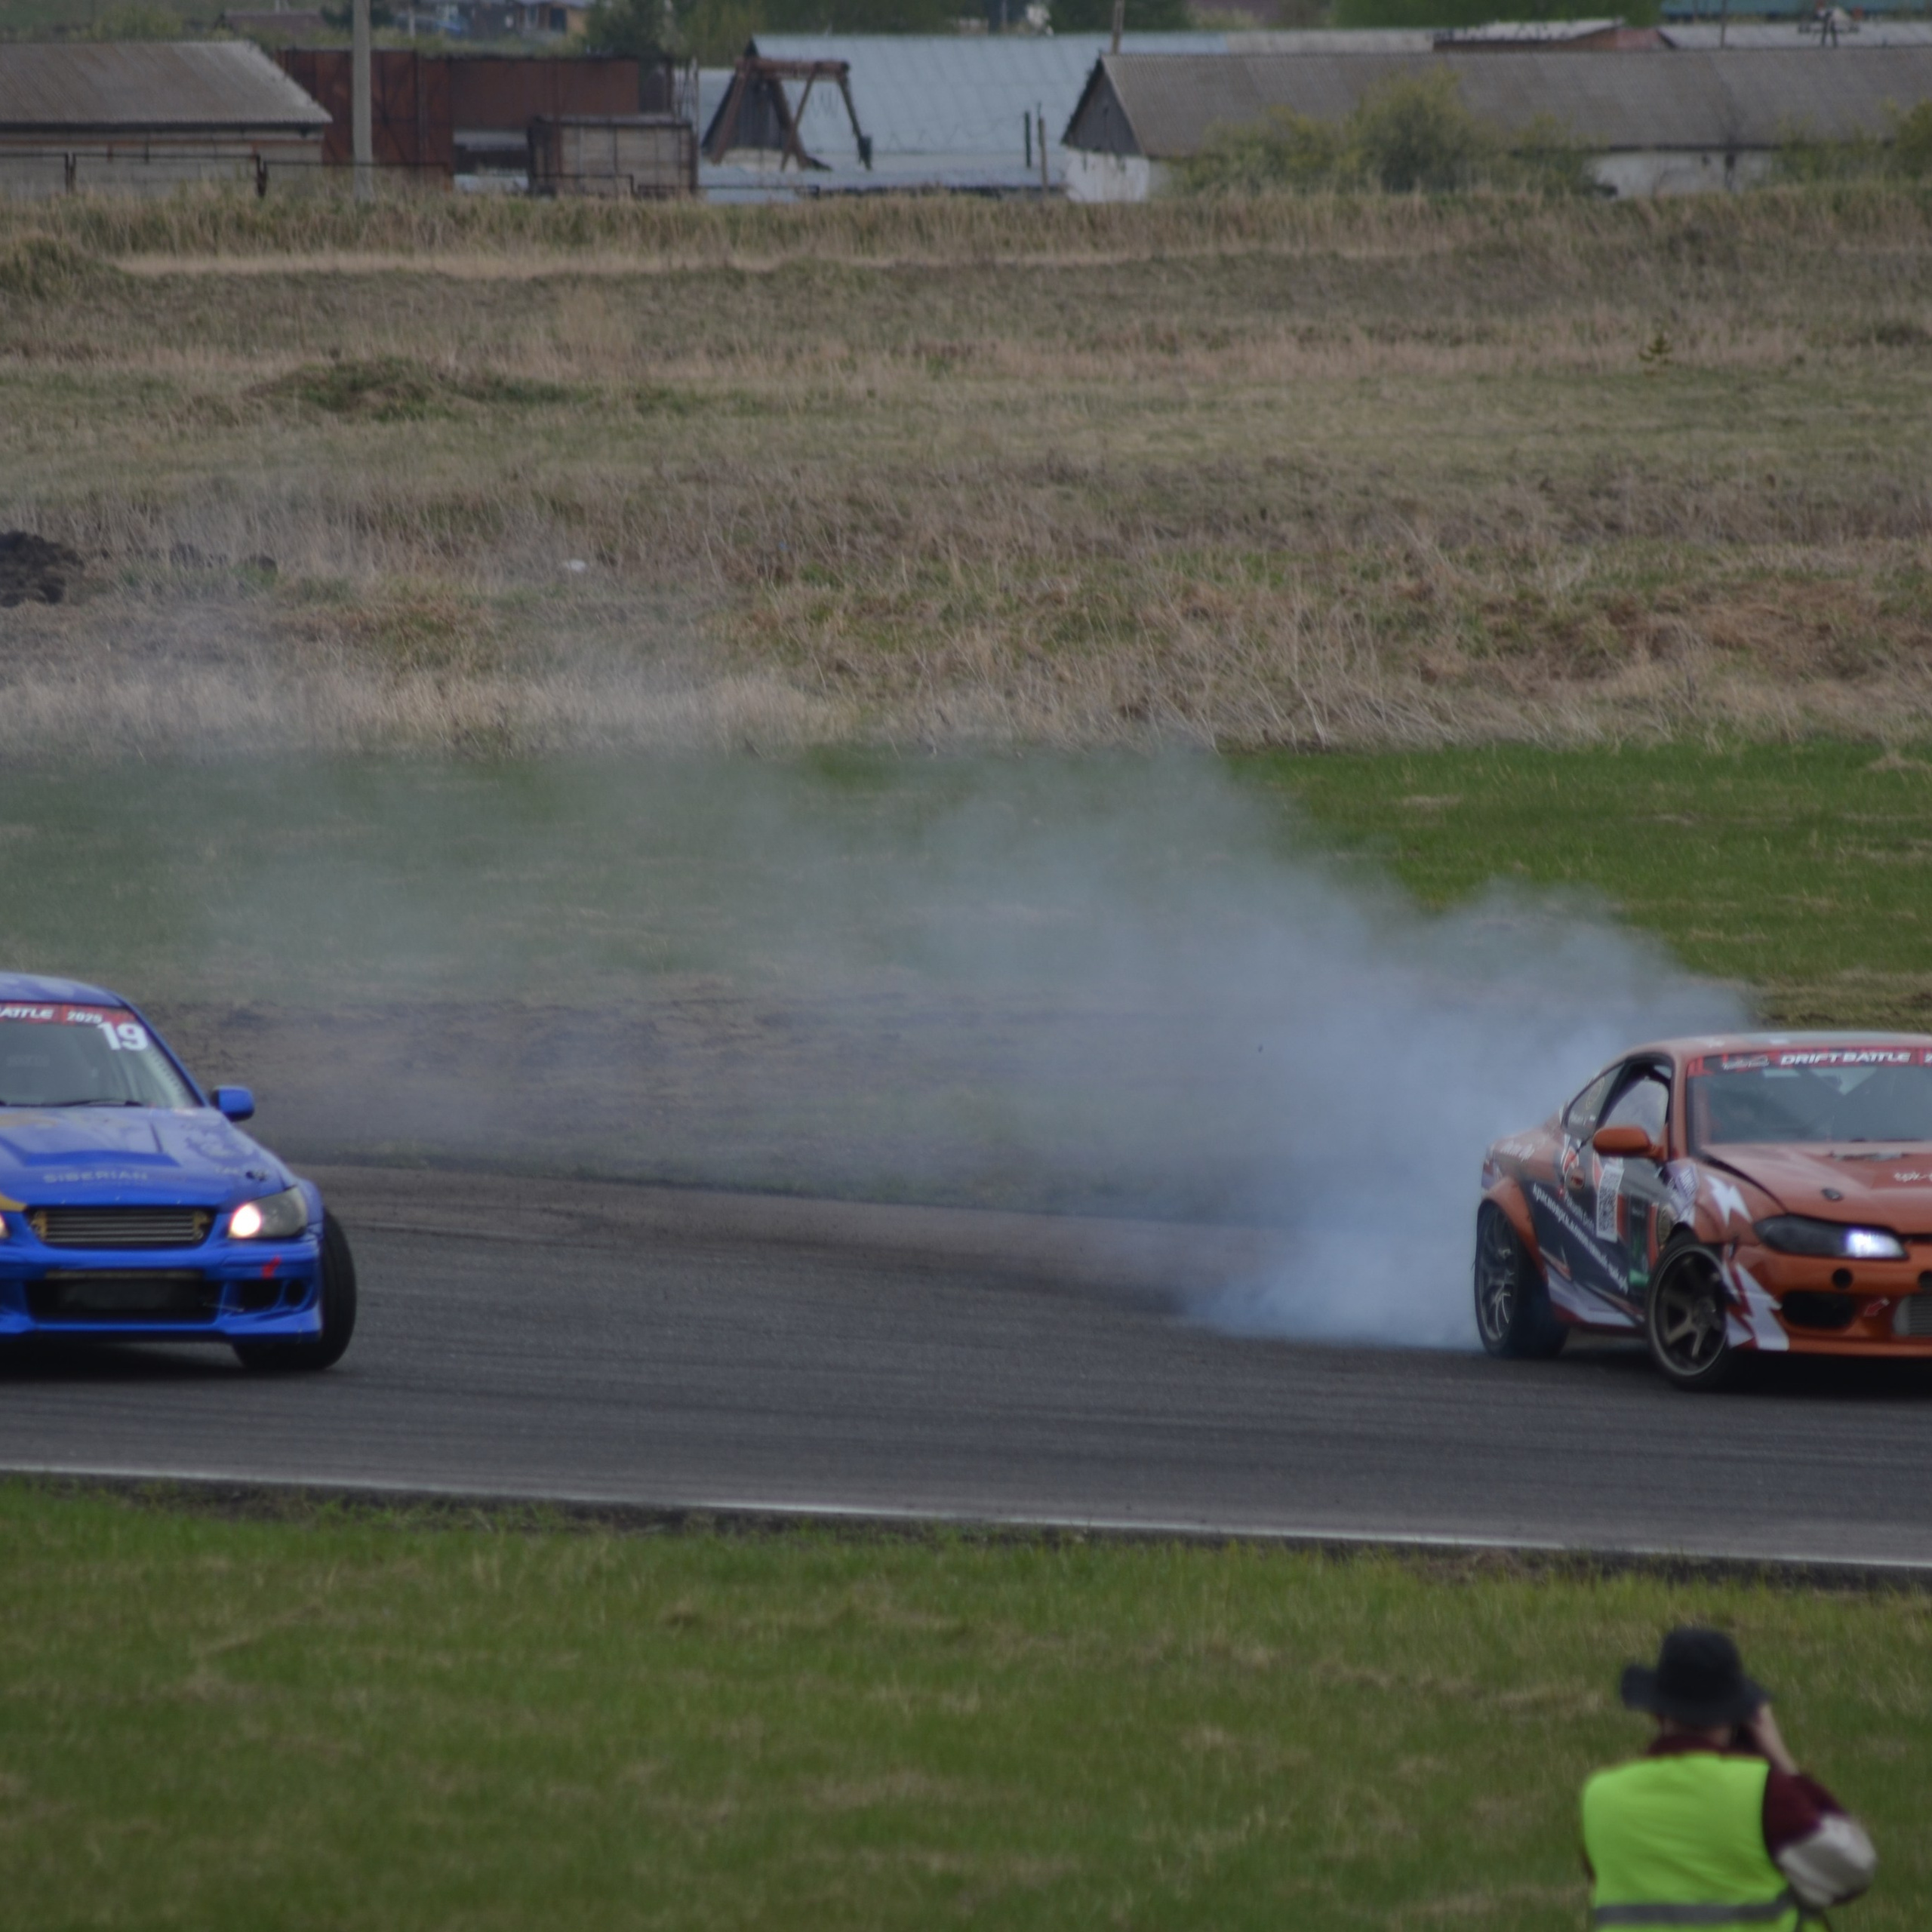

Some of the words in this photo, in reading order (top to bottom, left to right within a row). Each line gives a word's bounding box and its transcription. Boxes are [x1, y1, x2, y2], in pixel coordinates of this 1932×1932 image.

[0, 1007, 54, 1020] ATTLE
[97, 1022, 149, 1051] 19
[1780, 1052, 1843, 1066] DRIFT
[1842, 1051, 1912, 1063] BATTLE
[43, 1171, 148, 1184] SIBERIAN
